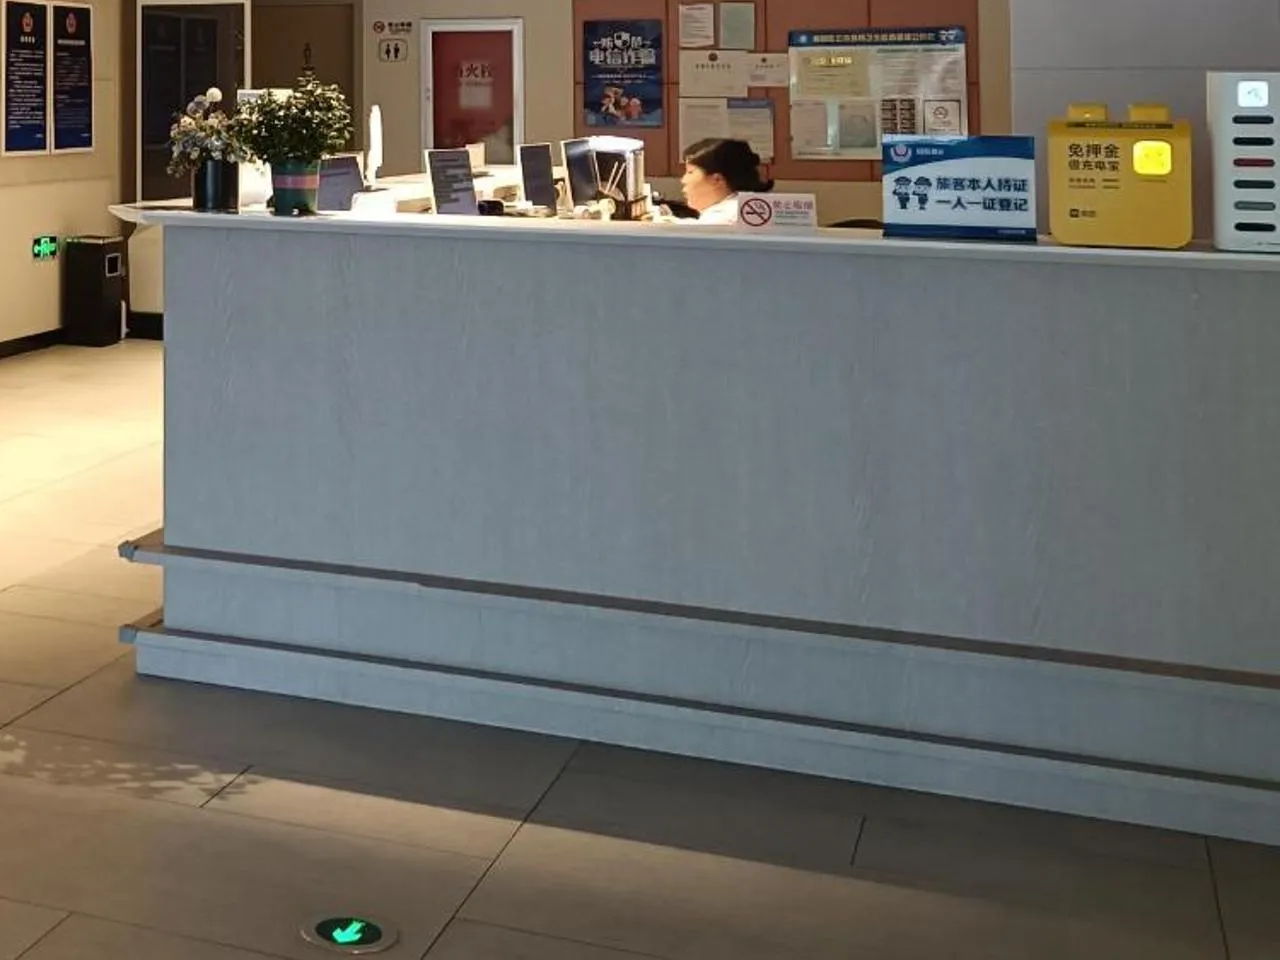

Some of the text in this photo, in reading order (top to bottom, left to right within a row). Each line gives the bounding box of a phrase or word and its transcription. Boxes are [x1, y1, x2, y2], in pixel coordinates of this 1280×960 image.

[1068, 143, 1121, 158] 免押金
[936, 177, 1029, 193] 旅客本人持证
[935, 196, 1029, 212] 一人一证登记
